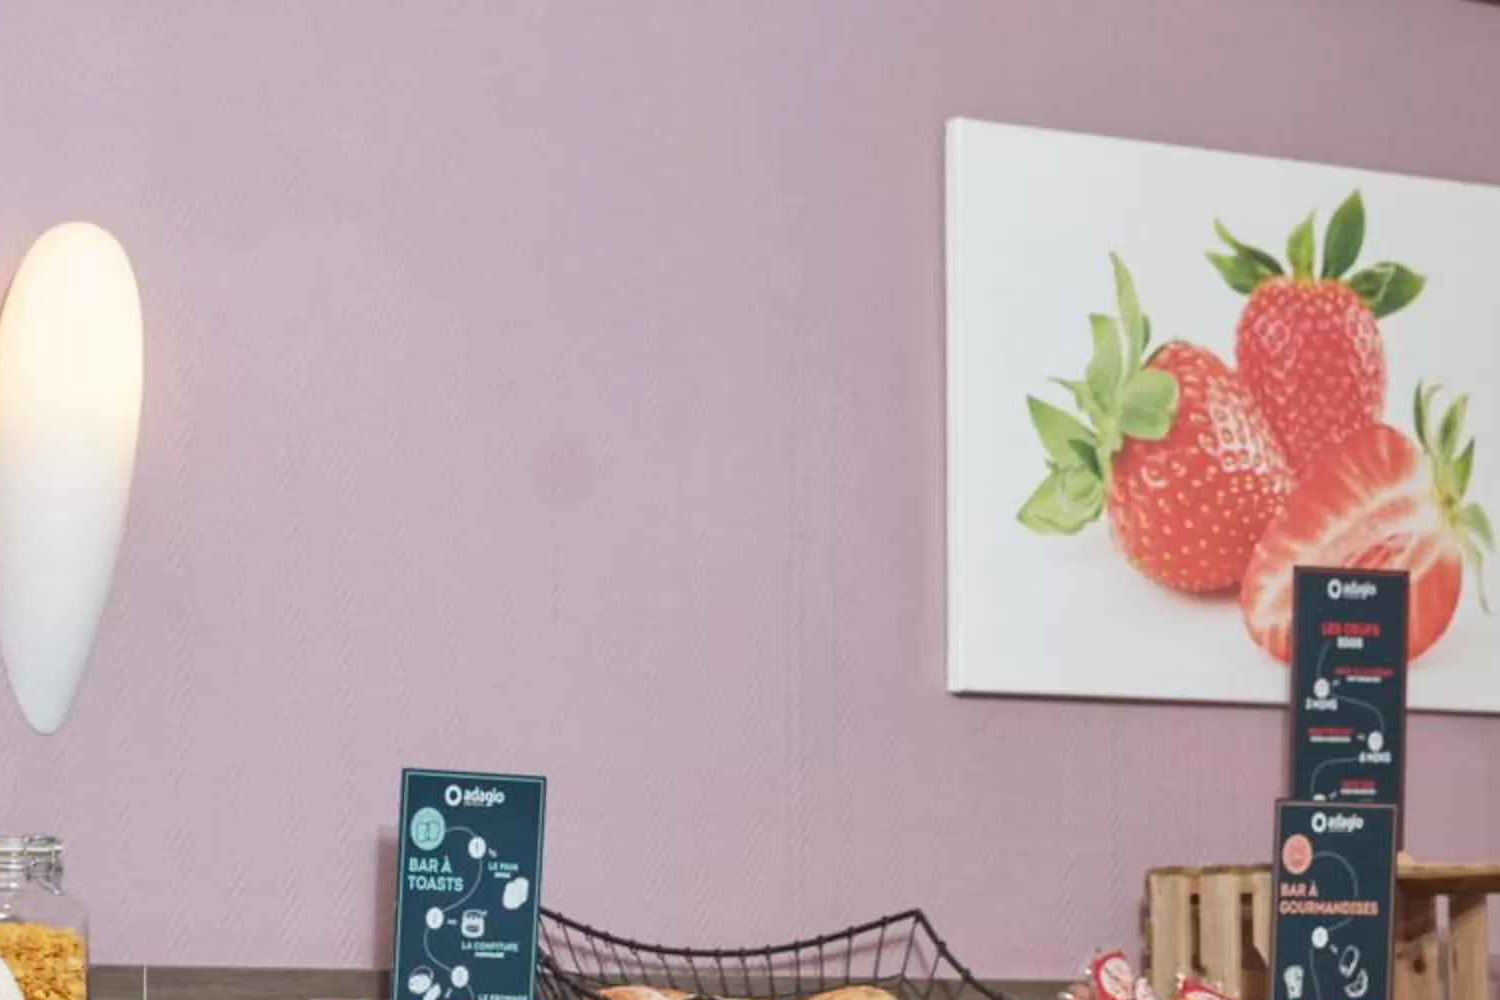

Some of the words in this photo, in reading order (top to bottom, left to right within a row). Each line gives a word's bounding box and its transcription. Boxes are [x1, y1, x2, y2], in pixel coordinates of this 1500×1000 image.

[463, 784, 505, 807] adagio
[408, 857, 438, 873] BAR
[441, 854, 453, 873] À
[407, 875, 464, 893] TOASTS
[1280, 882, 1306, 898] BAR
[1307, 879, 1319, 898] À
